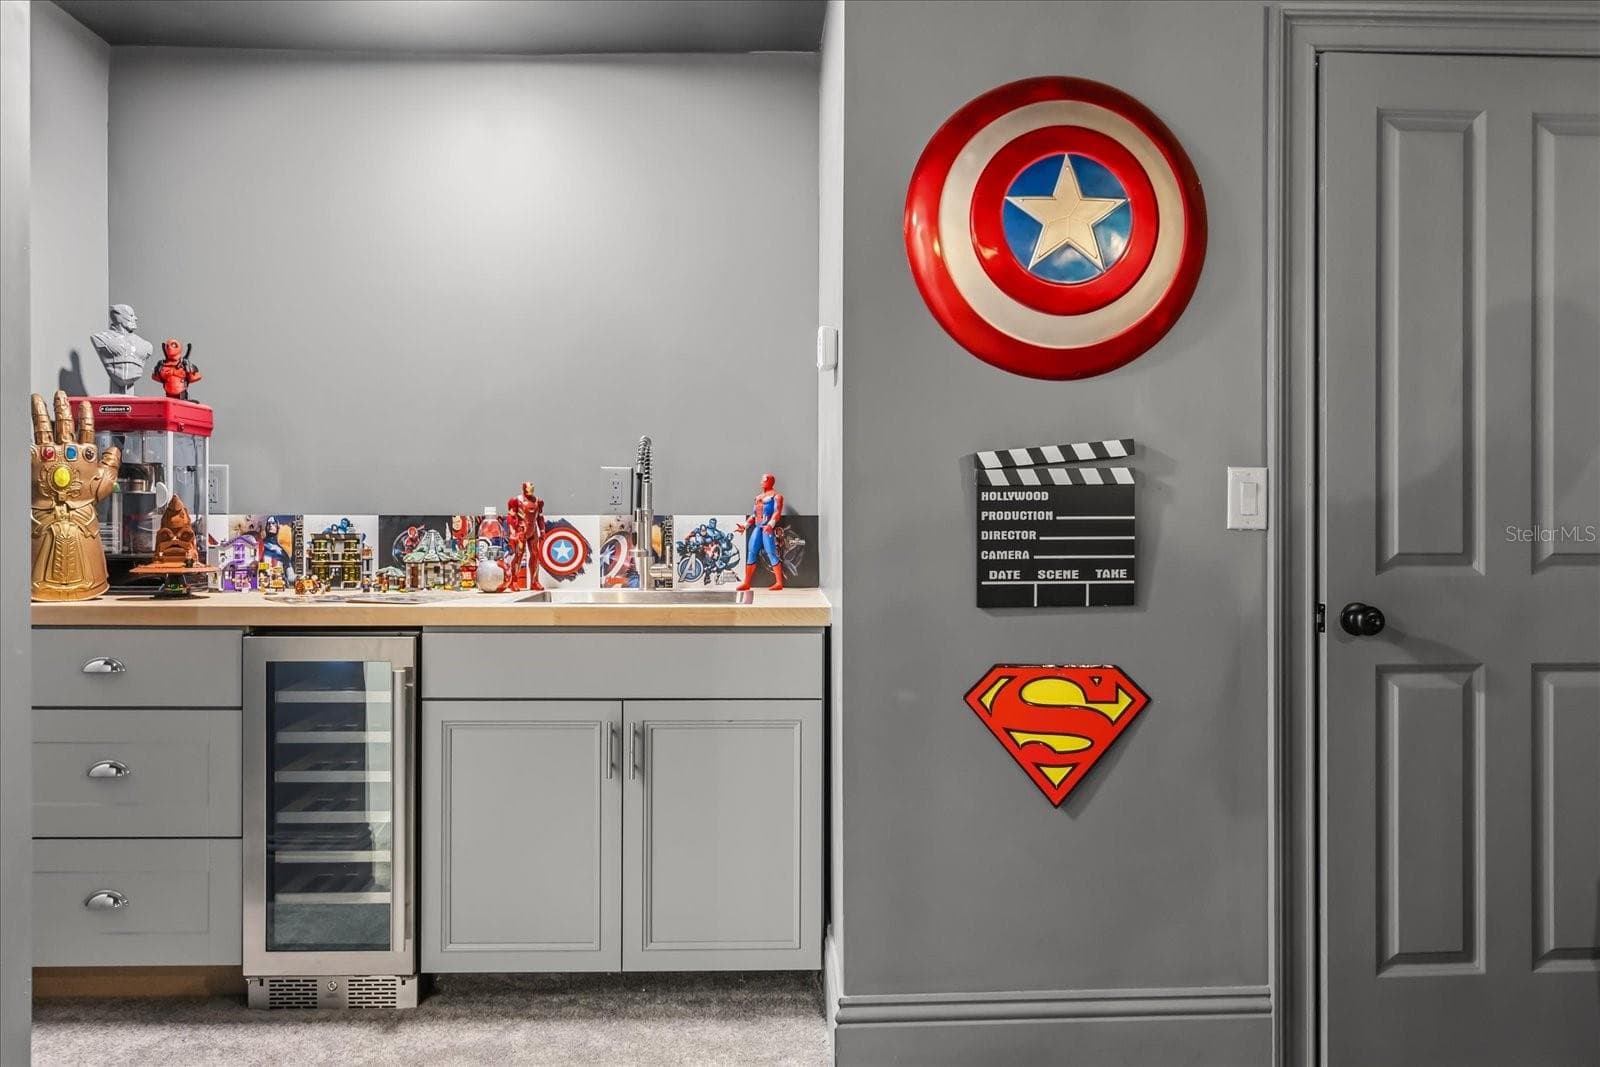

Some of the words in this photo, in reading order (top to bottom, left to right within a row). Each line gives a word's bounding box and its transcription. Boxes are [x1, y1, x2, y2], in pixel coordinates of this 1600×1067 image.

[981, 491, 1050, 501] HOLLYWOOD
[981, 510, 1054, 521] PRODUCTION
[981, 530, 1037, 541] DIRECTOR
[981, 550, 1030, 560] CAMERA
[988, 569, 1021, 580] DATE
[1037, 569, 1080, 580] SCENE
[1095, 568, 1127, 579] TAKE
